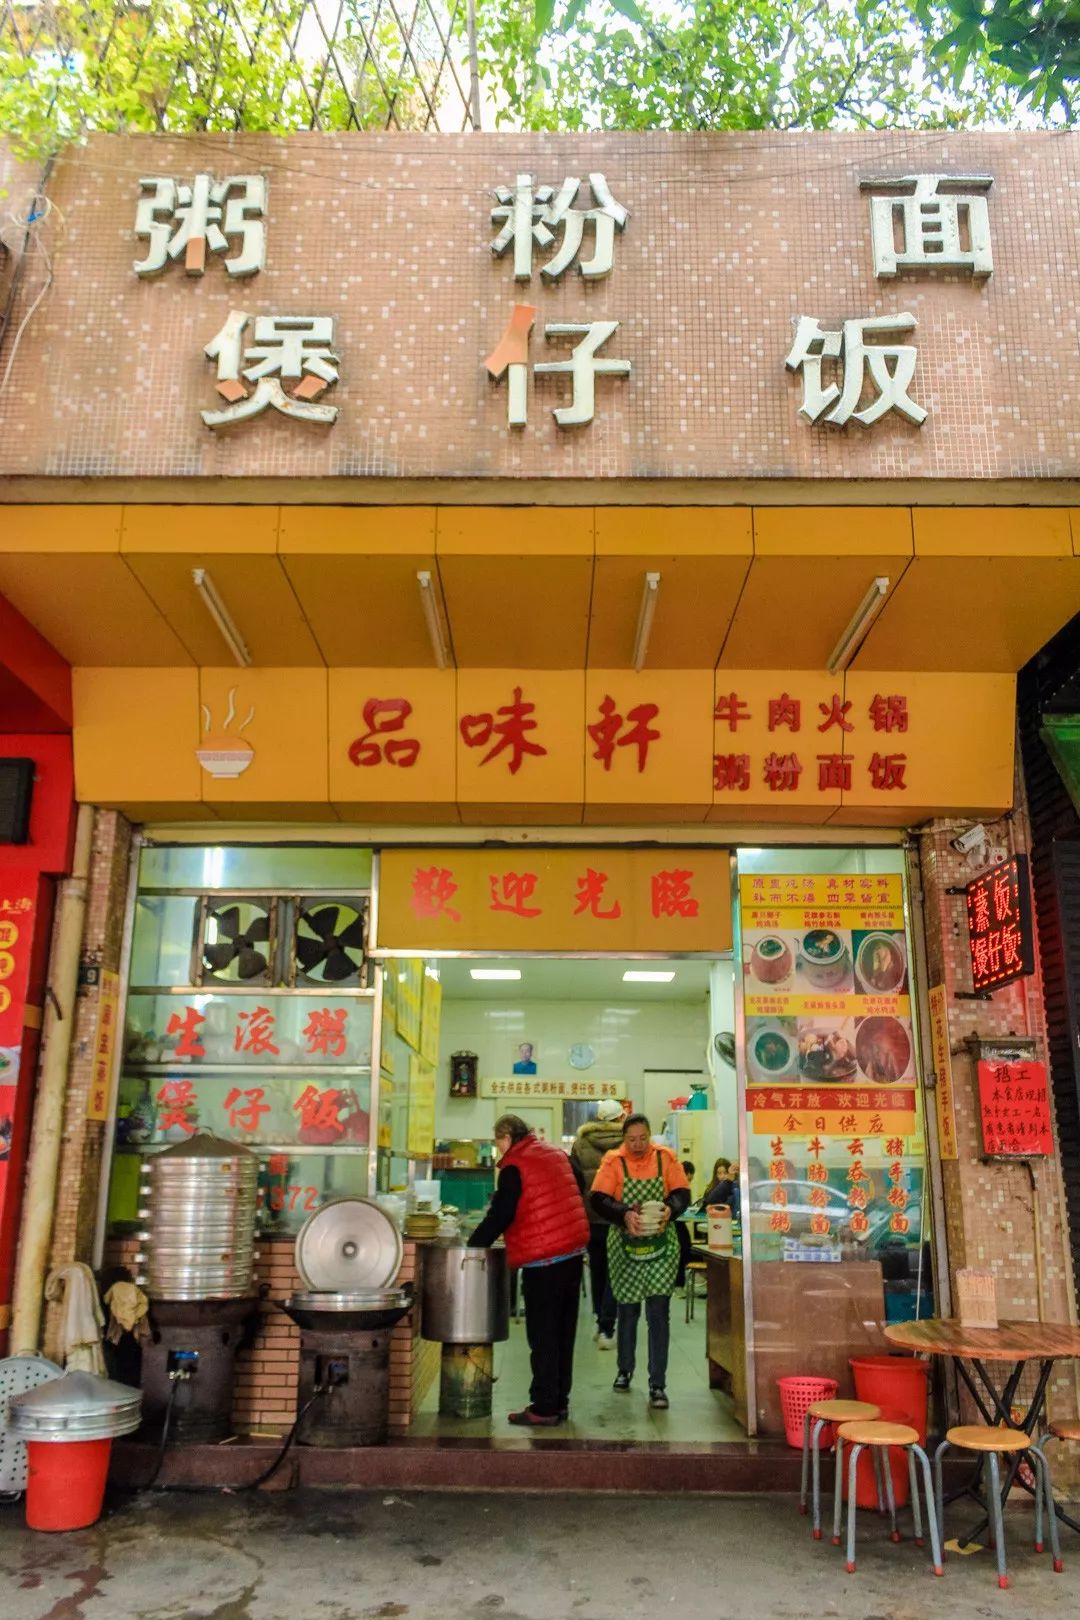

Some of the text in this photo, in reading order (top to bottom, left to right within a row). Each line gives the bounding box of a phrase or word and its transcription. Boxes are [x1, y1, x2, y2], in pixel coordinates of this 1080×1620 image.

[133, 172, 995, 279] 粥粉面
[201, 304, 930, 431] 煲仔饭
[713, 692, 909, 733] 牛肉火锅
[713, 752, 908, 791] 粥粉面饭
[87, 969, 97, 983] 9
[166, 1006, 348, 1057] 生滚粥
[753, 1092, 905, 1108] 冷气开放 欢迎光临
[784, 1113, 885, 1133] 全日供应
[847, 1137, 871, 1232] 云吞粉面
